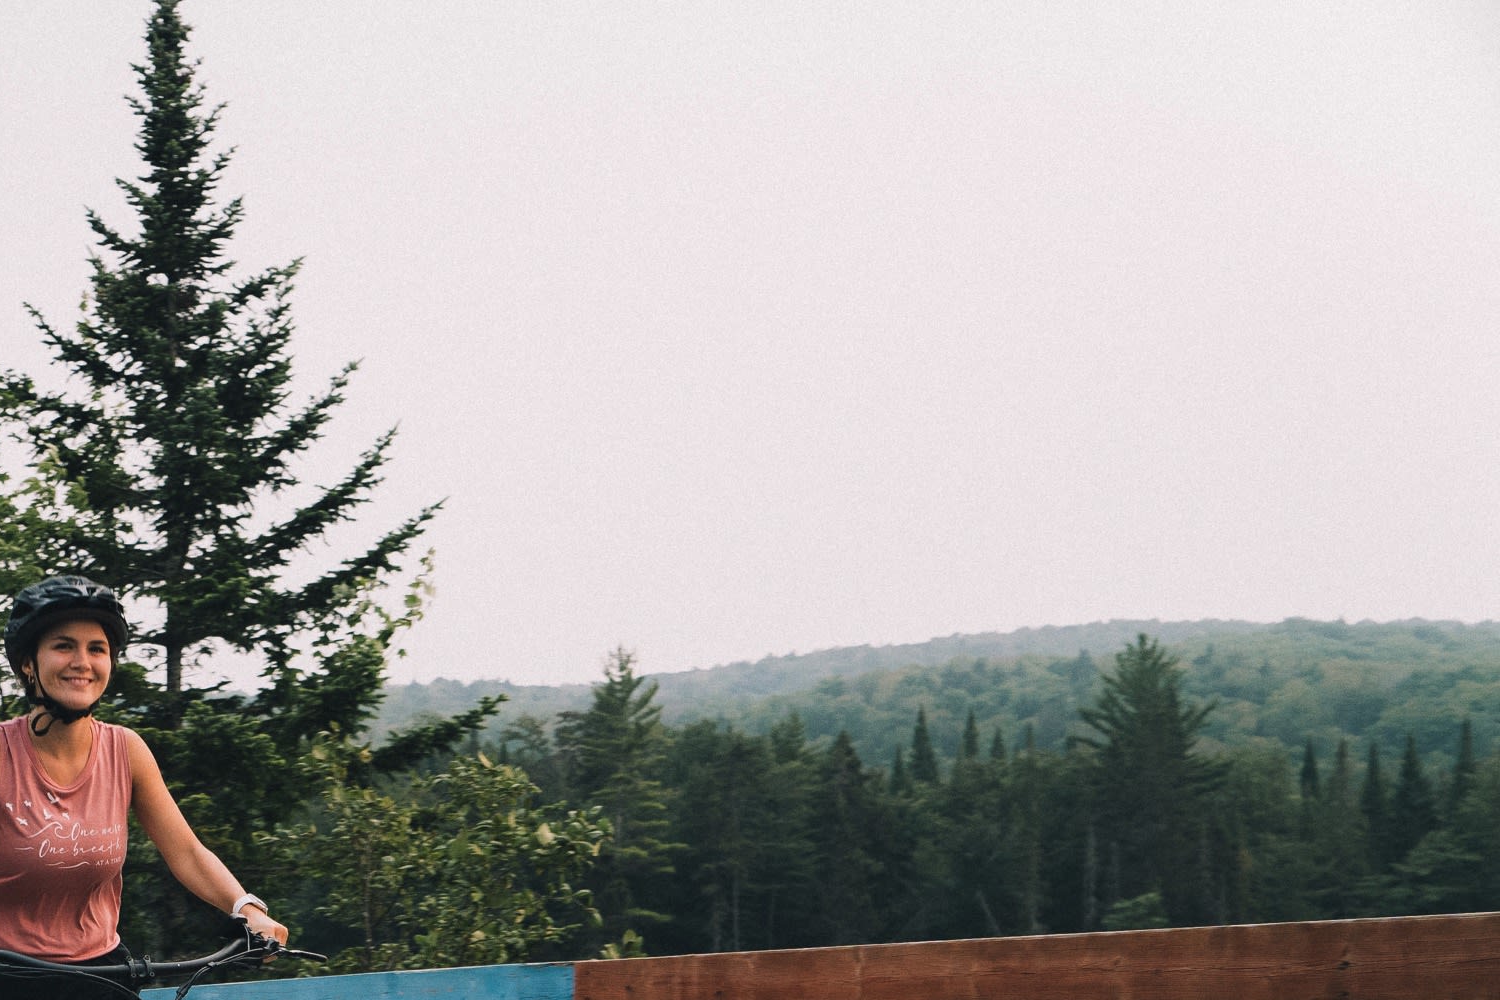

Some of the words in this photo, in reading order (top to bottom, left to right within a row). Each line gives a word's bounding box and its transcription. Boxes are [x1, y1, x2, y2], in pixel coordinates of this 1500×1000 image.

[71, 823, 98, 841] One
[39, 839, 68, 858] One
[73, 837, 121, 857] breath
